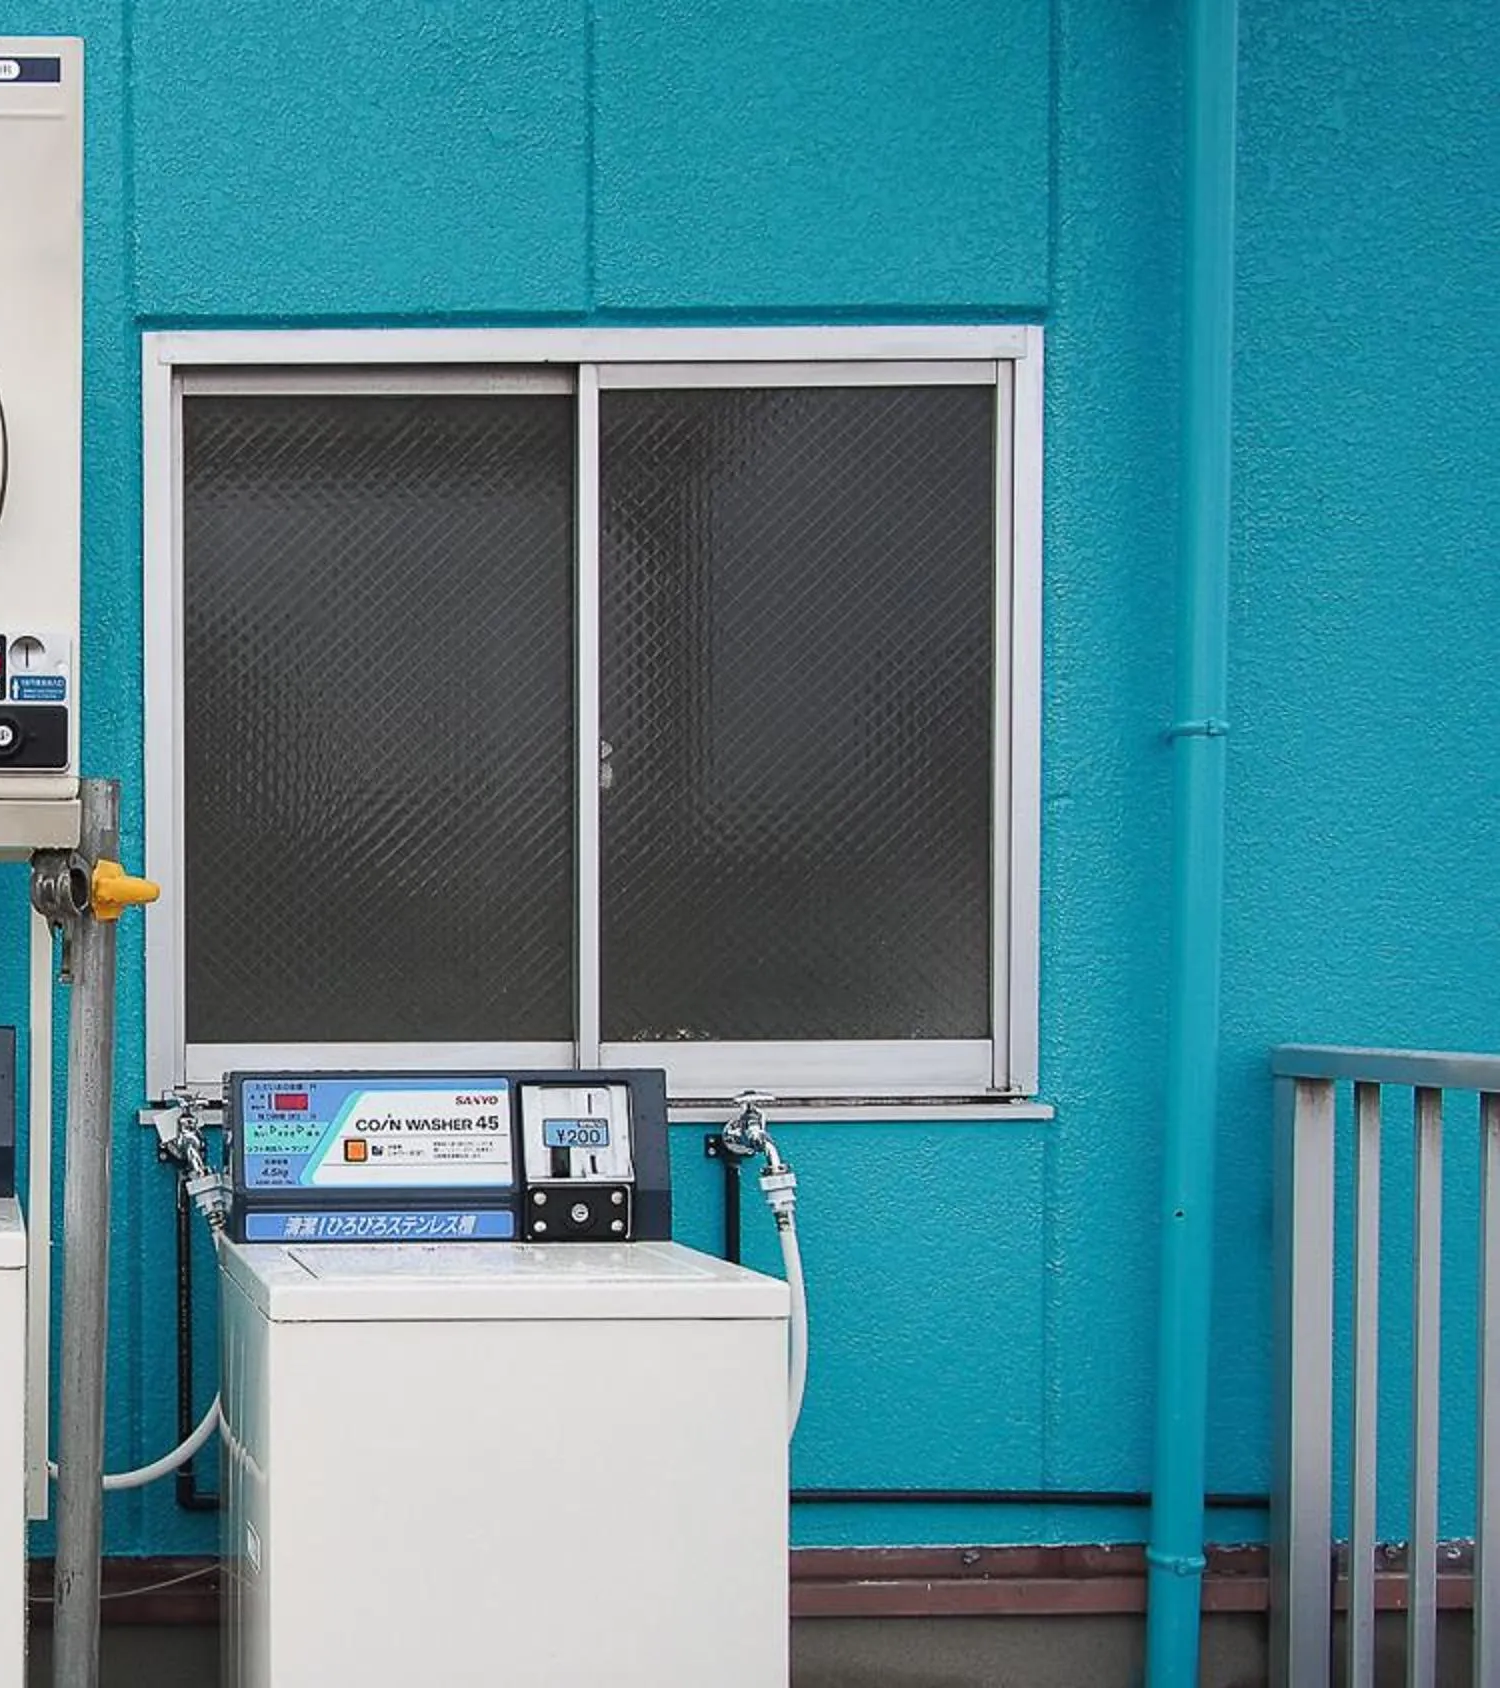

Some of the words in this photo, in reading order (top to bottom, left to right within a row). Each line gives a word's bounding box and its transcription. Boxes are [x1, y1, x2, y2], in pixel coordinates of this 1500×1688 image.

[455, 1095, 499, 1105] SANYO
[405, 1118, 473, 1131] WASHER
[475, 1115, 499, 1131] 45
[556, 1129, 601, 1144] ¥200
